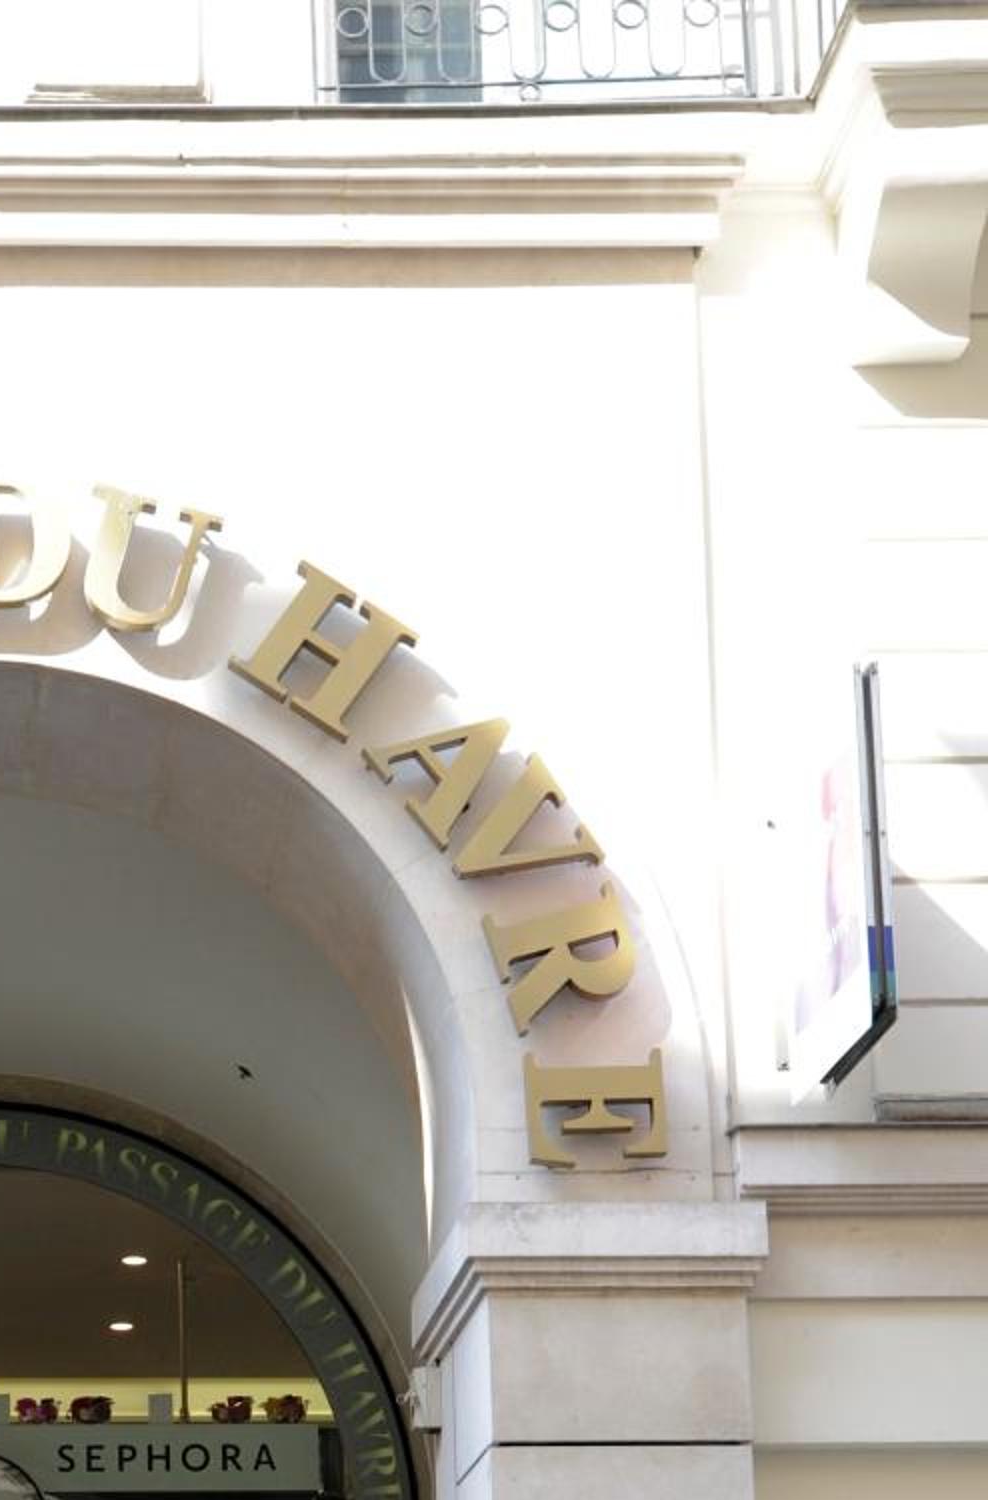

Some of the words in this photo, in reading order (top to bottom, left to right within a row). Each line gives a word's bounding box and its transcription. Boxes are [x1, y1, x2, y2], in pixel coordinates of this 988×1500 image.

[227, 559, 670, 1169] HAVRE
[55, 1127, 270, 1248] PASSAGE
[271, 1258, 340, 1324] DU
[57, 1443, 278, 1474] SEPHORA
